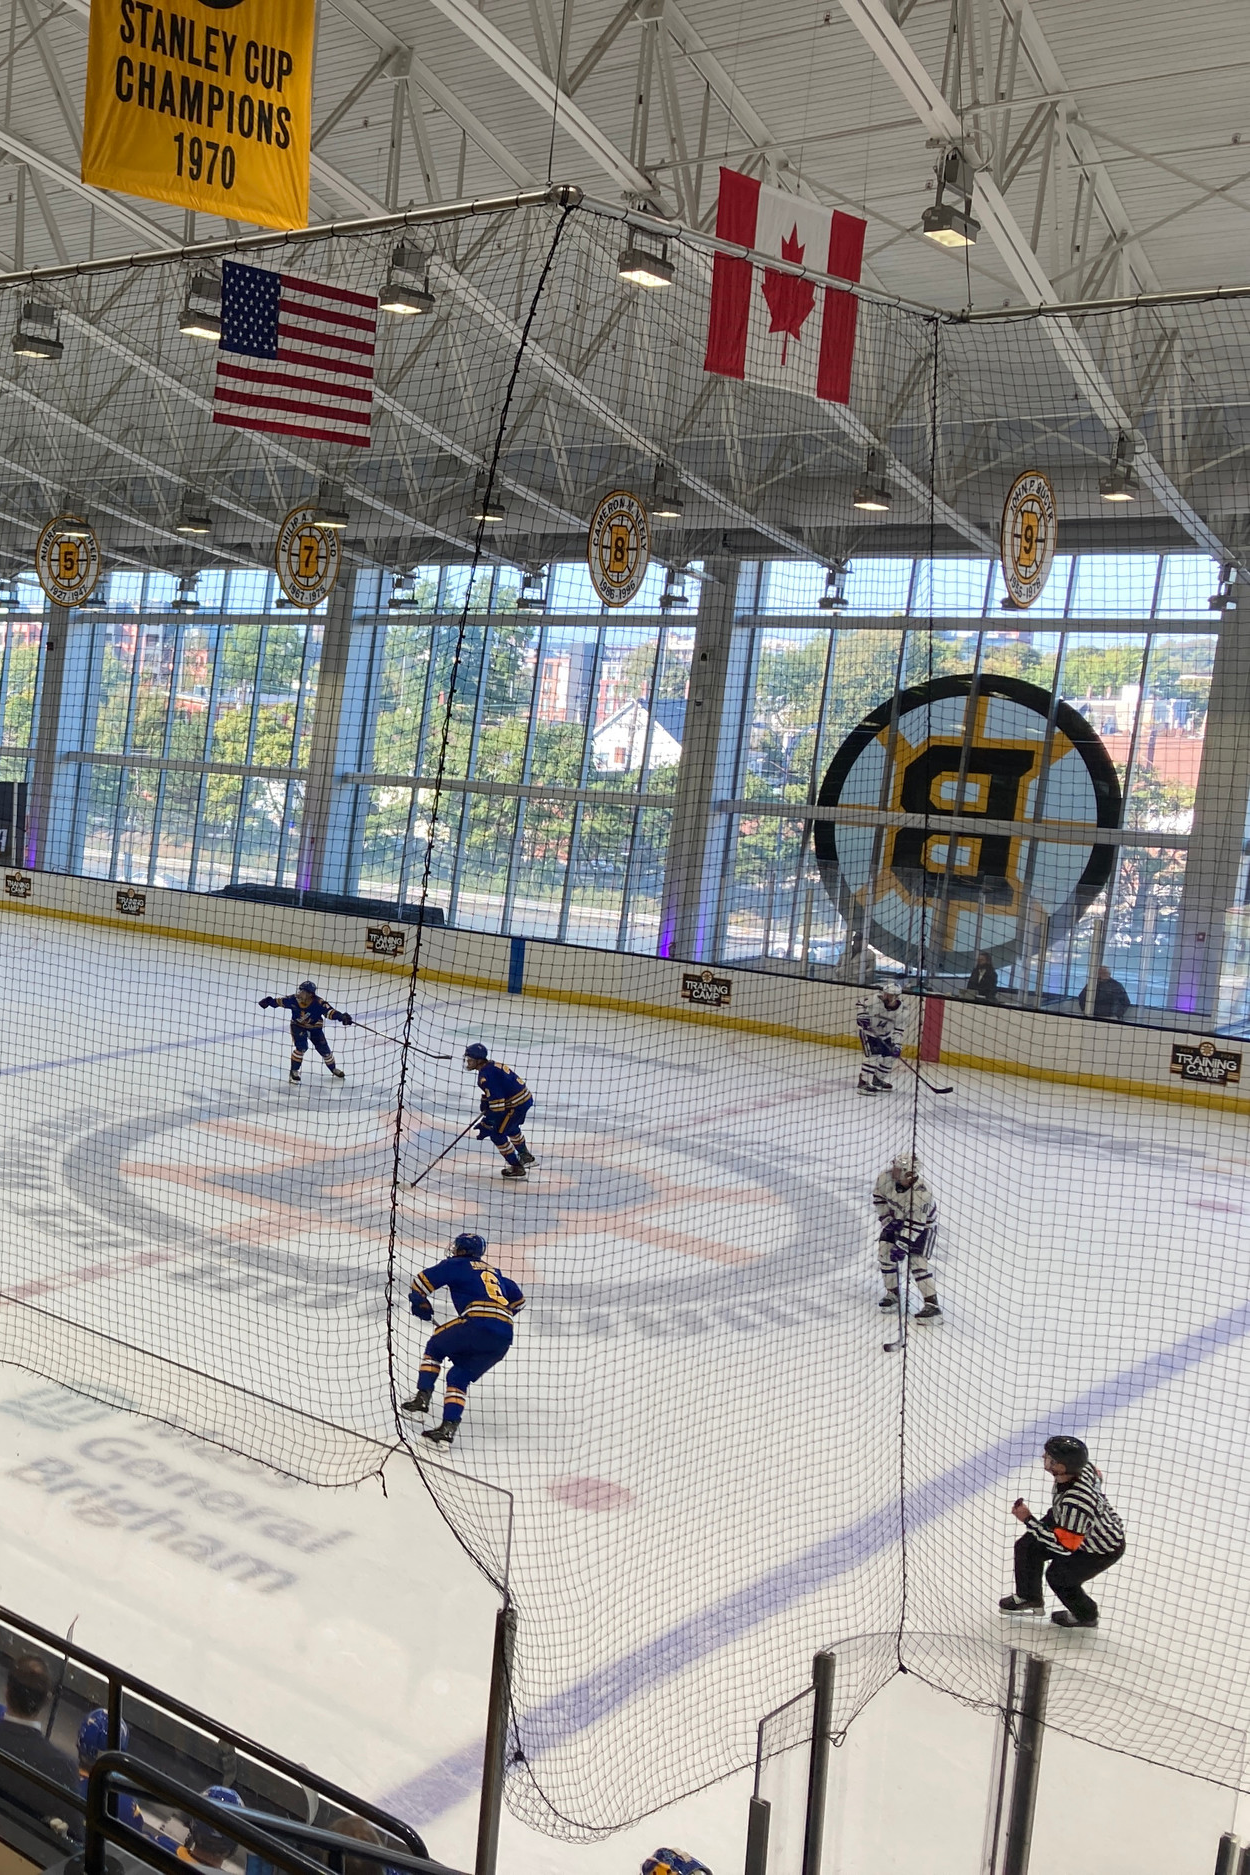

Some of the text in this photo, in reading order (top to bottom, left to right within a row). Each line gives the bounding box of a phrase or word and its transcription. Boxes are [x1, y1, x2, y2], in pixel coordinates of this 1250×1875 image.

[120, 0, 293, 93] STANLEY CUP
[115, 55, 291, 150] CHAMPIONS
[174, 132, 235, 190] 1970
[1010, 483, 1028, 512] JOHN
[281, 516, 299, 553] PHILIP
[593, 498, 625, 546] CAMERON
[635, 508, 647, 551] NEELY
[614, 537, 625, 562] 8
[1024, 525, 1034, 554] 9
[64, 551, 74, 571] 5
[304, 546, 314, 568] 7
[685, 980, 728, 994] TRAINING
[692, 989, 720, 1001] CAMP
[1176, 1053, 1237, 1071] TRAINING
[1186, 1064, 1225, 1078] CAMP
[480, 1270, 509, 1306] 6
[77, 1436, 356, 1555] General
[6, 1456, 299, 1594] Brigham
